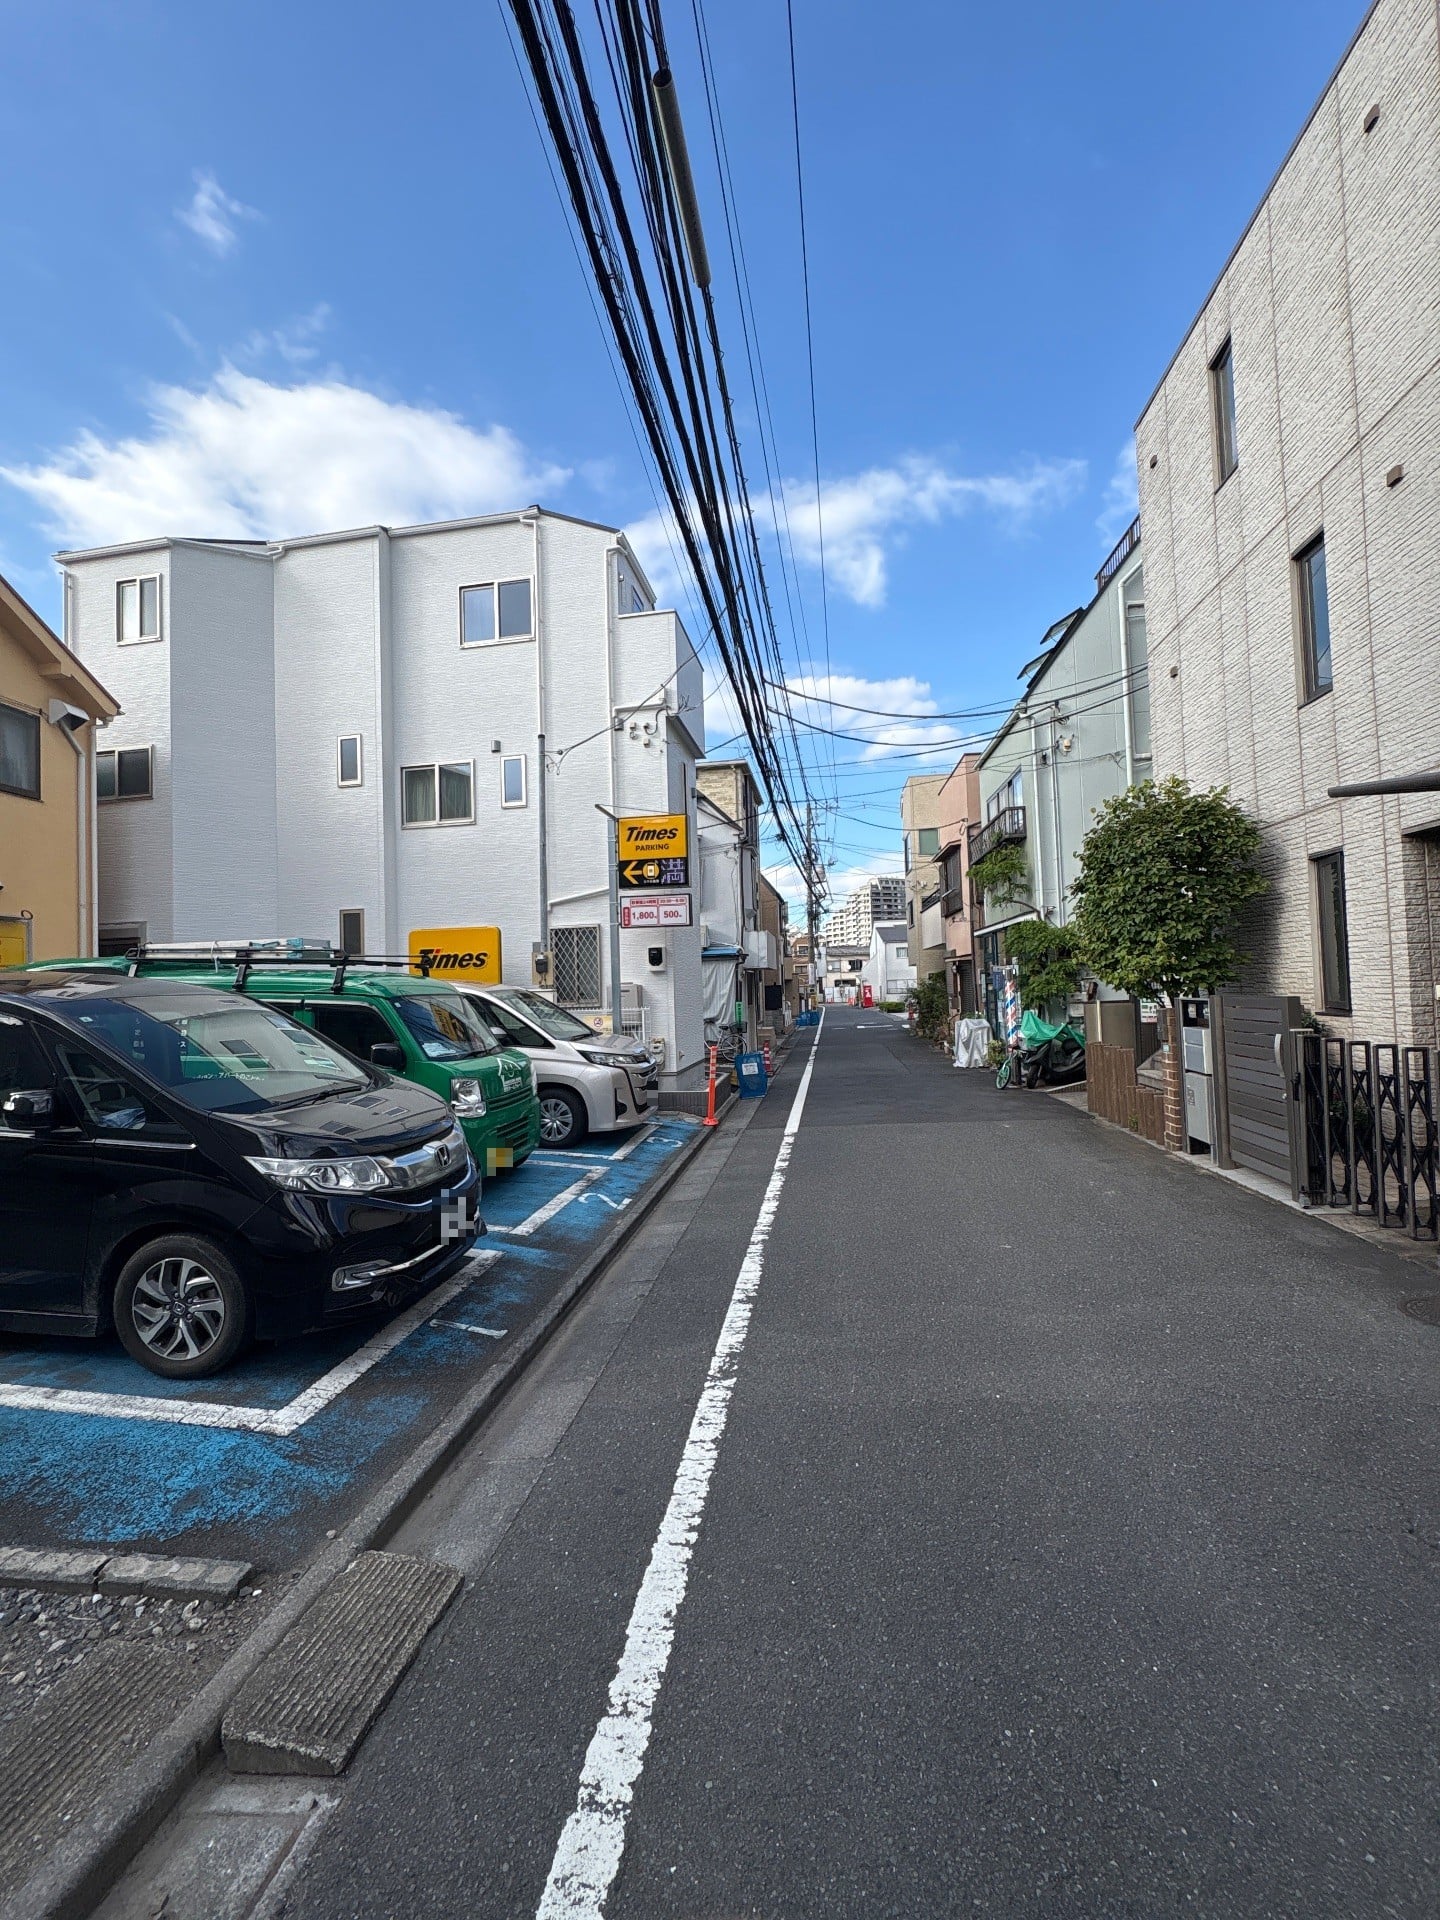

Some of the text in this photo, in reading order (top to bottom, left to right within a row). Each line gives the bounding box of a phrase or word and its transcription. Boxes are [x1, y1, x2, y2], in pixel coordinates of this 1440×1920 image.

[626, 826, 679, 842] Times
[635, 843, 670, 852] PARKING
[660, 858, 686, 885] 満
[647, 1136, 684, 1148] 3
[578, 1192, 633, 1211] 2
